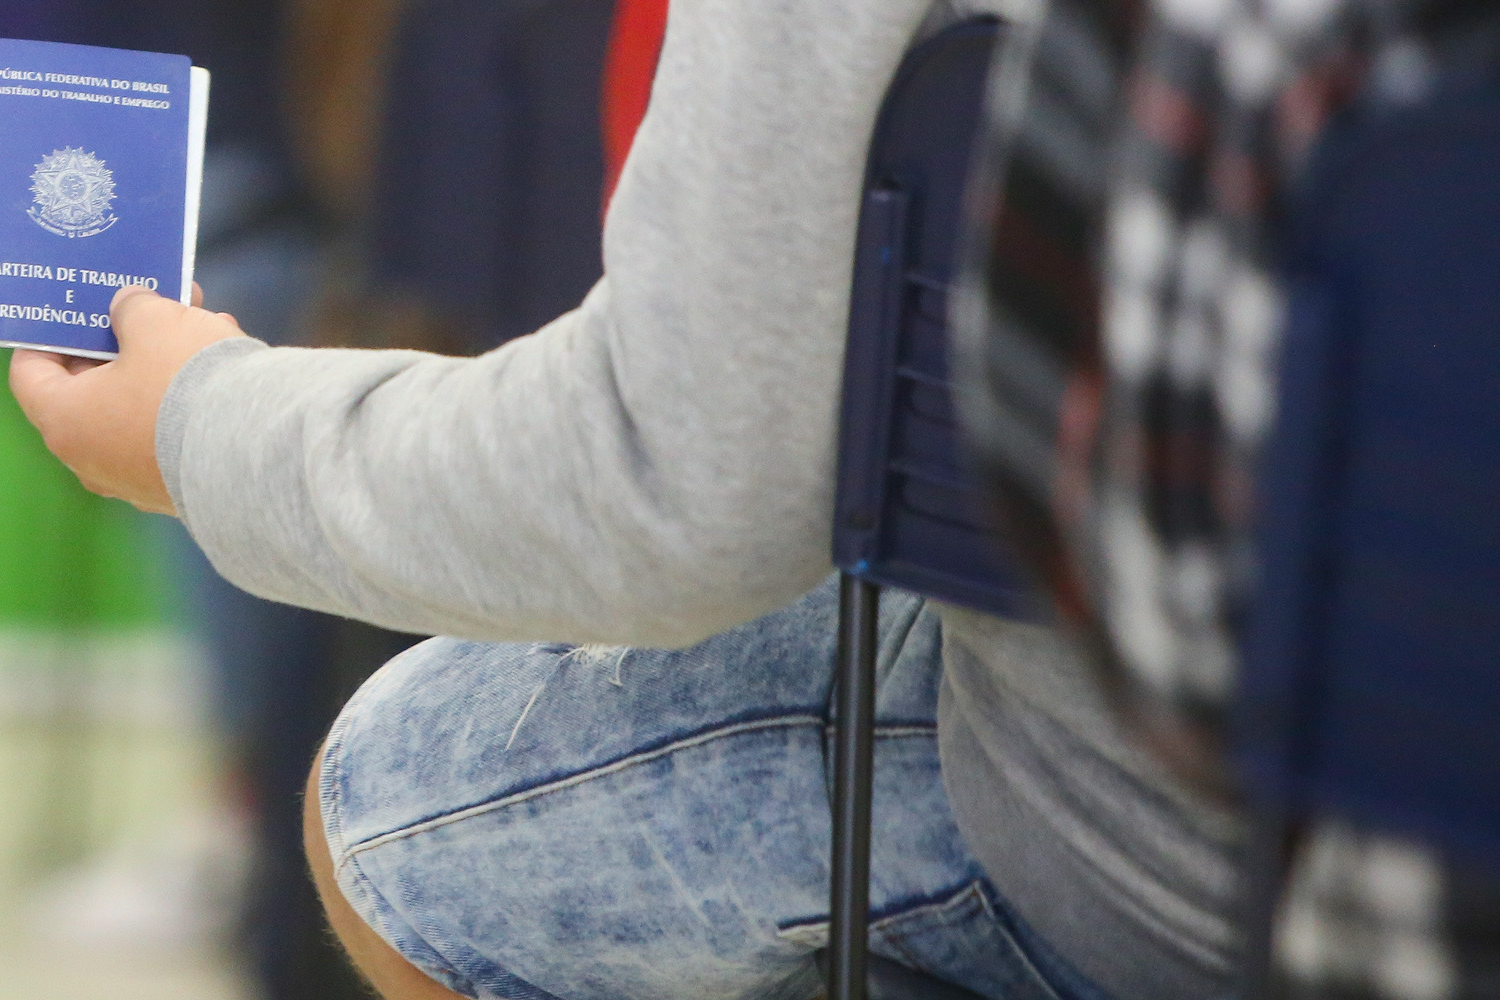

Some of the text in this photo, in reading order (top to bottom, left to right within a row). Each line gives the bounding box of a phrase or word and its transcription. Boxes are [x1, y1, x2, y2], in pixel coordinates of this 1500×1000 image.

[45, 73, 109, 88] FEDERATIVA
[111, 80, 130, 90] DO
[132, 82, 170, 94] BRASIL
[42, 90, 59, 98] DO
[61, 91, 112, 104] TRABALHO
[113, 96, 120, 105] E
[121, 97, 170, 110] EMPREGO
[56, 267, 77, 282] DE
[80, 269, 158, 291] TRABALHO
[65, 289, 74, 303] E
